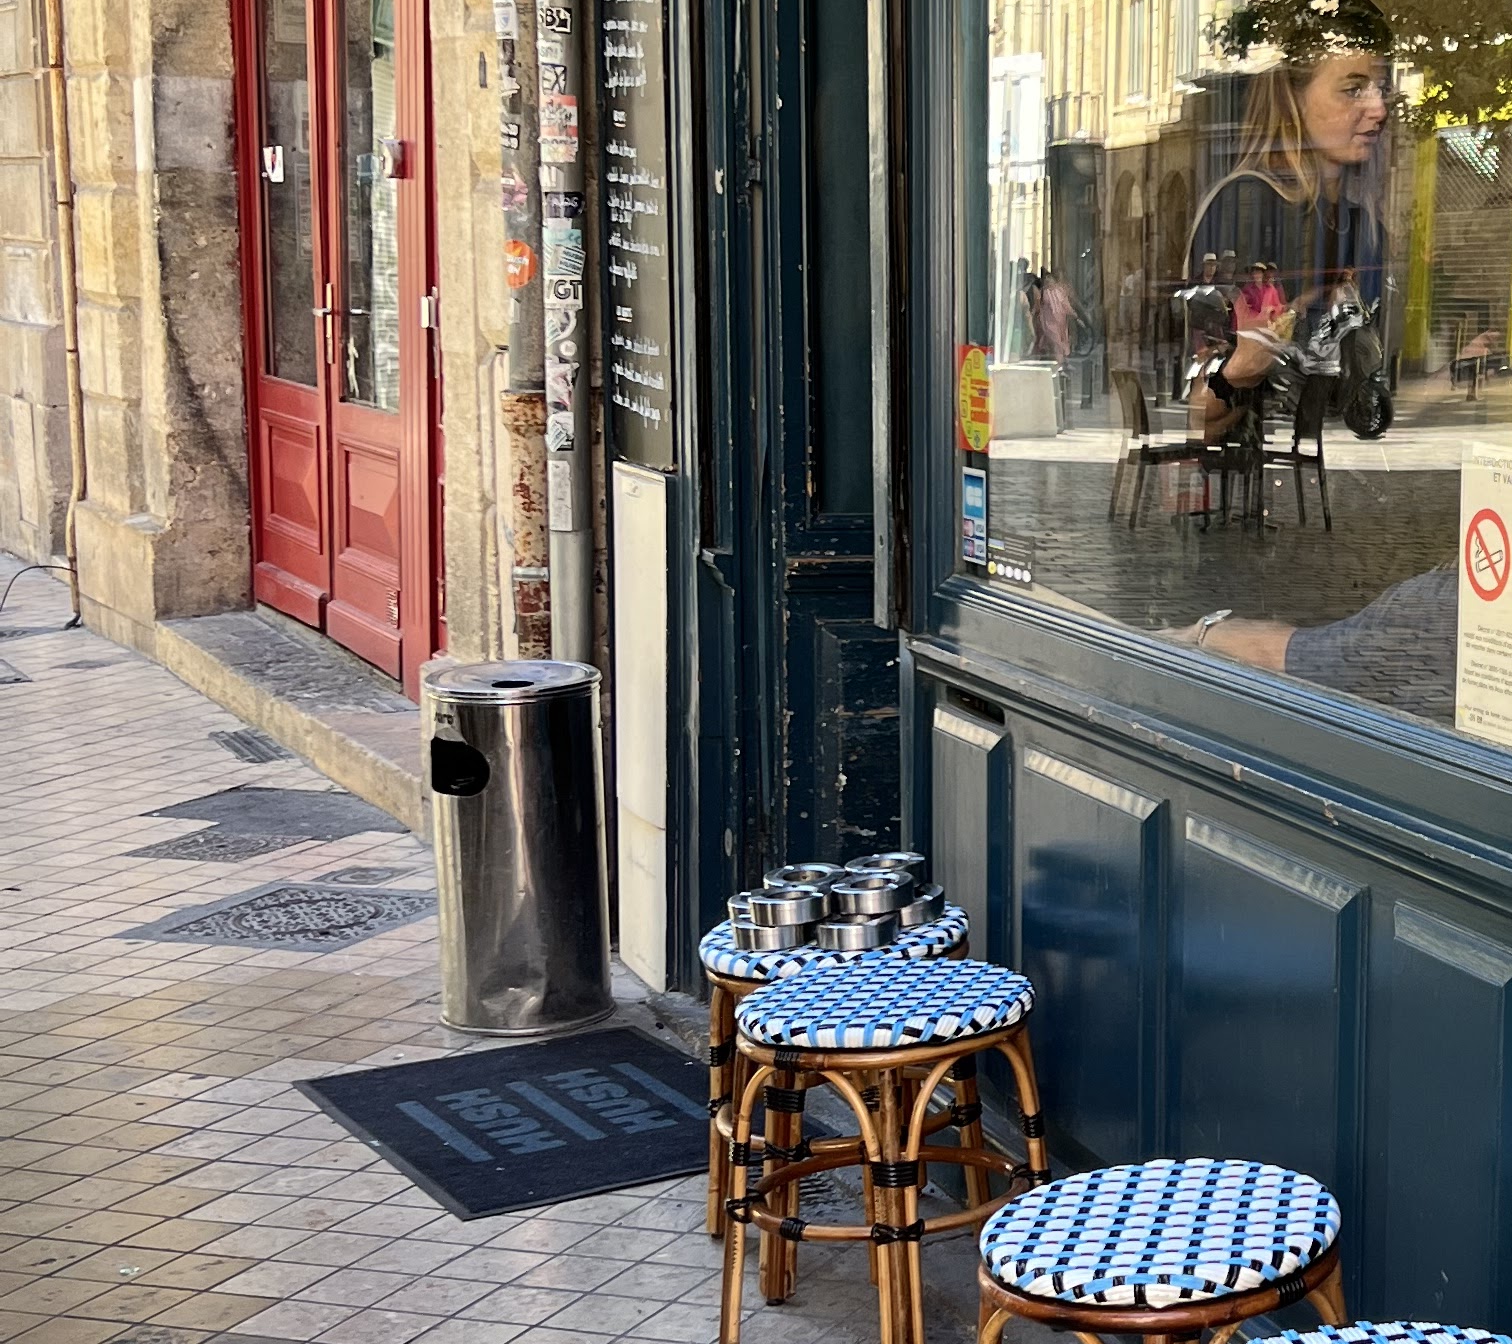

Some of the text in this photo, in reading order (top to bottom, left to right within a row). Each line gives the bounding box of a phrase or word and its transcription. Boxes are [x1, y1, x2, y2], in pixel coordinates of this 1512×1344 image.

[1493, 472, 1501, 483] ET
[437, 1088, 567, 1154] HUSH
[543, 1068, 678, 1134] HUSH
